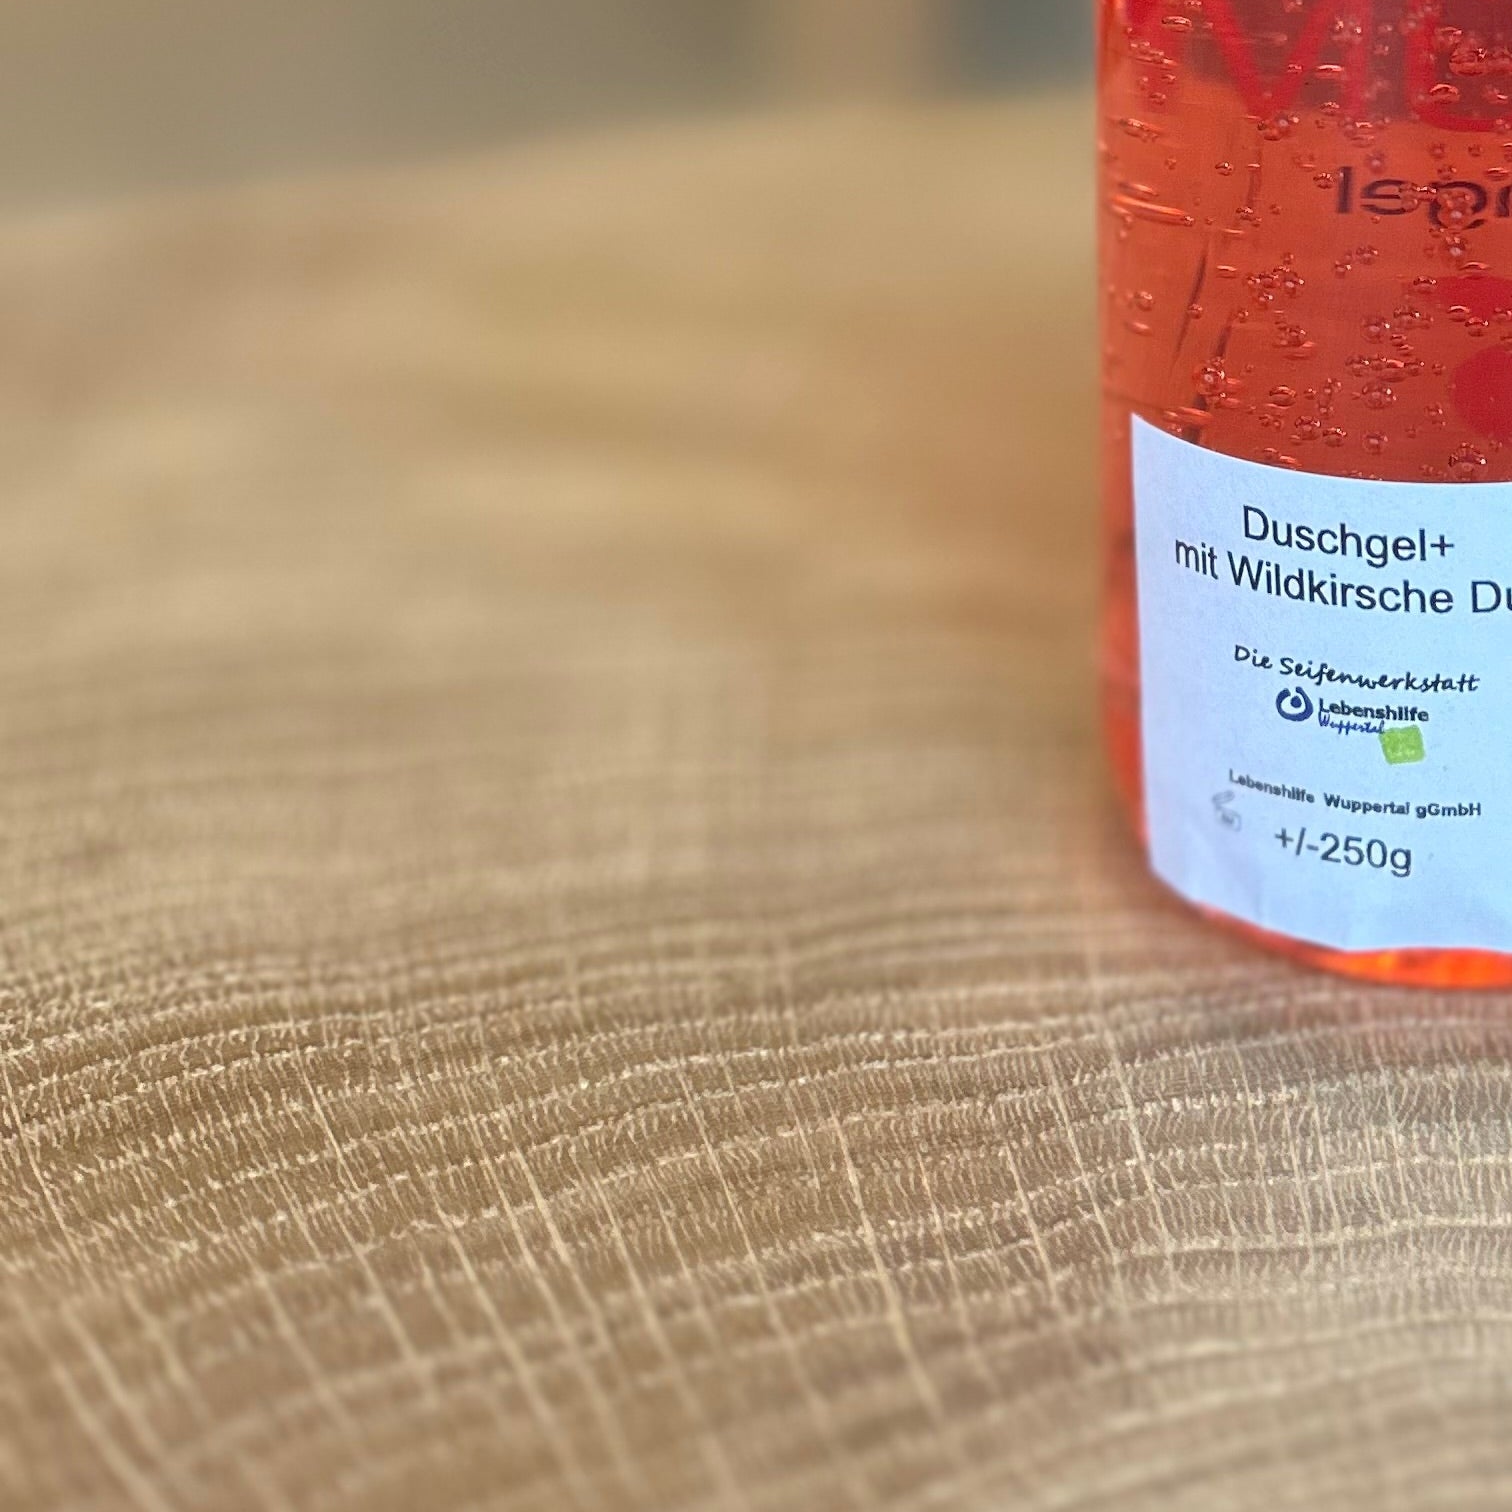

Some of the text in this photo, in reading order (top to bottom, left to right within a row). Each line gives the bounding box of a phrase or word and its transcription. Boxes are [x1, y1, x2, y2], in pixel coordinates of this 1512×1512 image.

[1243, 505, 1455, 569] Duschgel+
[1174, 538, 1219, 579] mit
[1227, 551, 1454, 614] Wildkirsche
[1234, 644, 1480, 693] Die Seifenwerkstatt
[1318, 697, 1430, 724] Lebenshilfe
[1228, 768, 1482, 820] Lebenshilfe Wuppertal gGmbH
[1273, 826, 1413, 878] +/-250g
